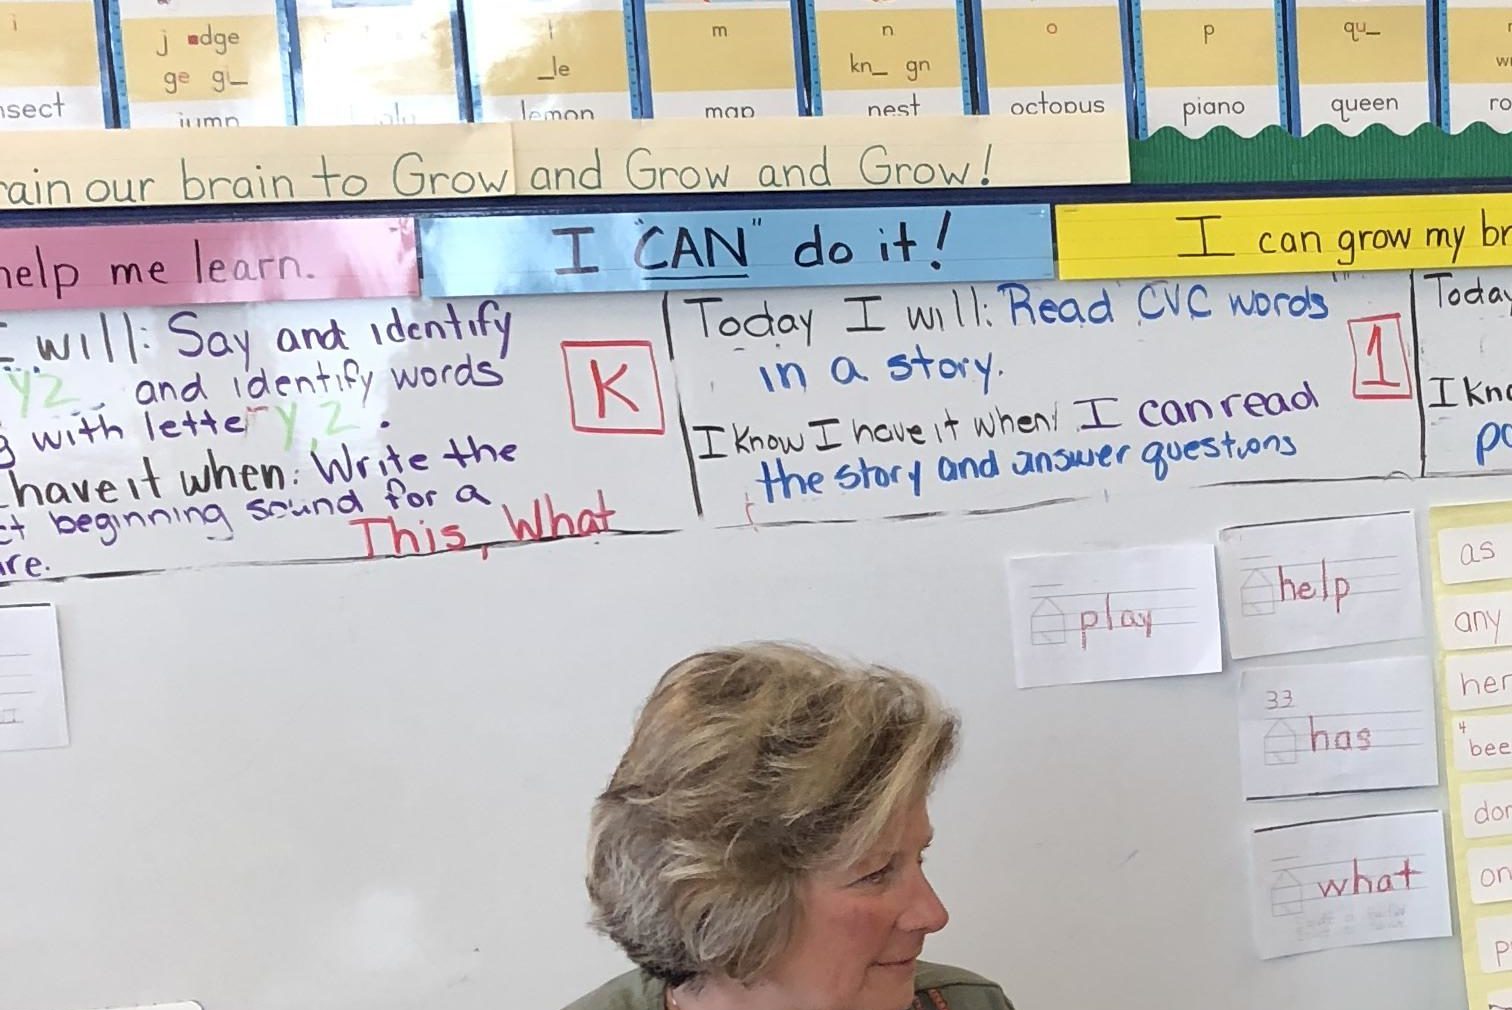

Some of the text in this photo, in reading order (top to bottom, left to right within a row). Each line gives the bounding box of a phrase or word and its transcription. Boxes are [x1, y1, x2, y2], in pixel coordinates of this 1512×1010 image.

[155, 29, 169, 57] j
[711, 25, 728, 38] m
[882, 24, 894, 37] n
[1046, 23, 1059, 35] o
[1203, 24, 1215, 45] p
[906, 58, 931, 82] gn
[0, 91, 66, 119] sect
[520, 100, 595, 121] lemon
[704, 104, 756, 119] map
[867, 93, 921, 117] nest
[1010, 91, 1106, 116] octopus
[1182, 97, 1246, 127] piano
[1331, 95, 1400, 123] queen
[86, 178, 155, 202] our
[181, 157, 294, 202] brain
[311, 154, 368, 198] to
[392, 151, 509, 198] Grow
[530, 147, 601, 191] and
[626, 147, 730, 191] Grow
[758, 144, 831, 189] and
[859, 143, 993, 187] Grow!
[551, 225, 599, 275] I
[793, 223, 854, 268] do
[879, 210, 953, 270] it!
[1176, 214, 1236, 257] I
[1259, 228, 1322, 254] can
[1337, 224, 1412, 266] grow
[1425, 225, 1466, 264] my
[111, 260, 169, 285] me
[193, 238, 316, 284] learn.
[683, 296, 813, 347] Today
[844, 295, 886, 333] I
[998, 283, 1115, 325] Read
[1137, 283, 1211, 320] CVC
[1230, 285, 1329, 319] words
[168, 310, 250, 372] Say
[276, 318, 350, 353] and
[370, 299, 512, 360] identify
[1361, 324, 1401, 387] 1
[135, 352, 504, 409] and identify words
[590, 359, 640, 419] K
[759, 361, 807, 394] in
[831, 356, 869, 385] a
[1428, 376, 1457, 408] I
[32, 414, 124, 452] with
[692, 424, 728, 460] I
[808, 418, 842, 451] I
[851, 416, 927, 445] have
[934, 408, 960, 444] it
[1073, 397, 1123, 430] I
[1138, 398, 1214, 429] can
[1220, 380, 1321, 419] read
[9, 466, 118, 507] have
[129, 457, 163, 500] it
[310, 442, 430, 485] Write
[443, 435, 518, 468] the
[757, 430, 1298, 503] the story and answer questions
[48, 503, 235, 547] beginning
[246, 489, 364, 523] sound
[384, 477, 437, 511] for
[456, 483, 493, 507] a
[502, 489, 616, 541] What
[1460, 540, 1496, 566] as
[1278, 559, 1351, 614] help
[1080, 593, 1153, 650] play
[1454, 608, 1502, 644] any
[1264, 689, 1295, 710] 33
[1309, 714, 1373, 753] has
[1317, 856, 1423, 898] what
